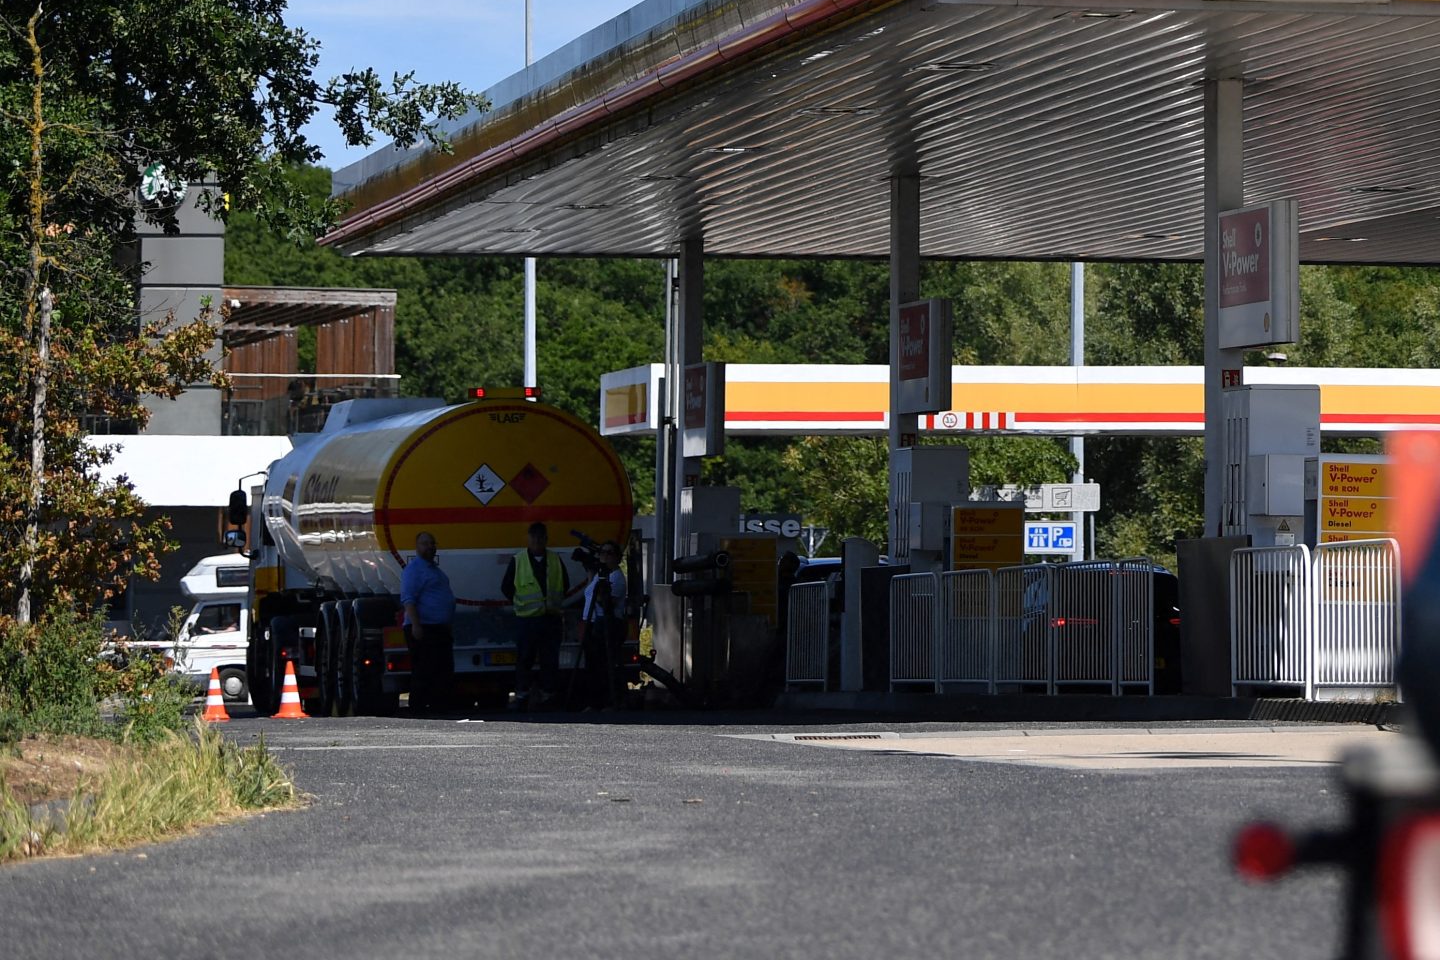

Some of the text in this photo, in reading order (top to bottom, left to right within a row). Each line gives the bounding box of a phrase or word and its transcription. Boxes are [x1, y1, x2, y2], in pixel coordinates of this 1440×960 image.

[1223, 227, 1236, 249] Shell
[1222, 251, 1260, 278] V-Power
[497, 412, 520, 424] LAG
[1329, 464, 1349, 473] Shell
[1329, 473, 1375, 484] V-Power
[1328, 500, 1349, 508] Shell
[1329, 508, 1374, 519] V-Power
[1328, 520, 1352, 528] Diesel
[1053, 527, 1063, 541] P
